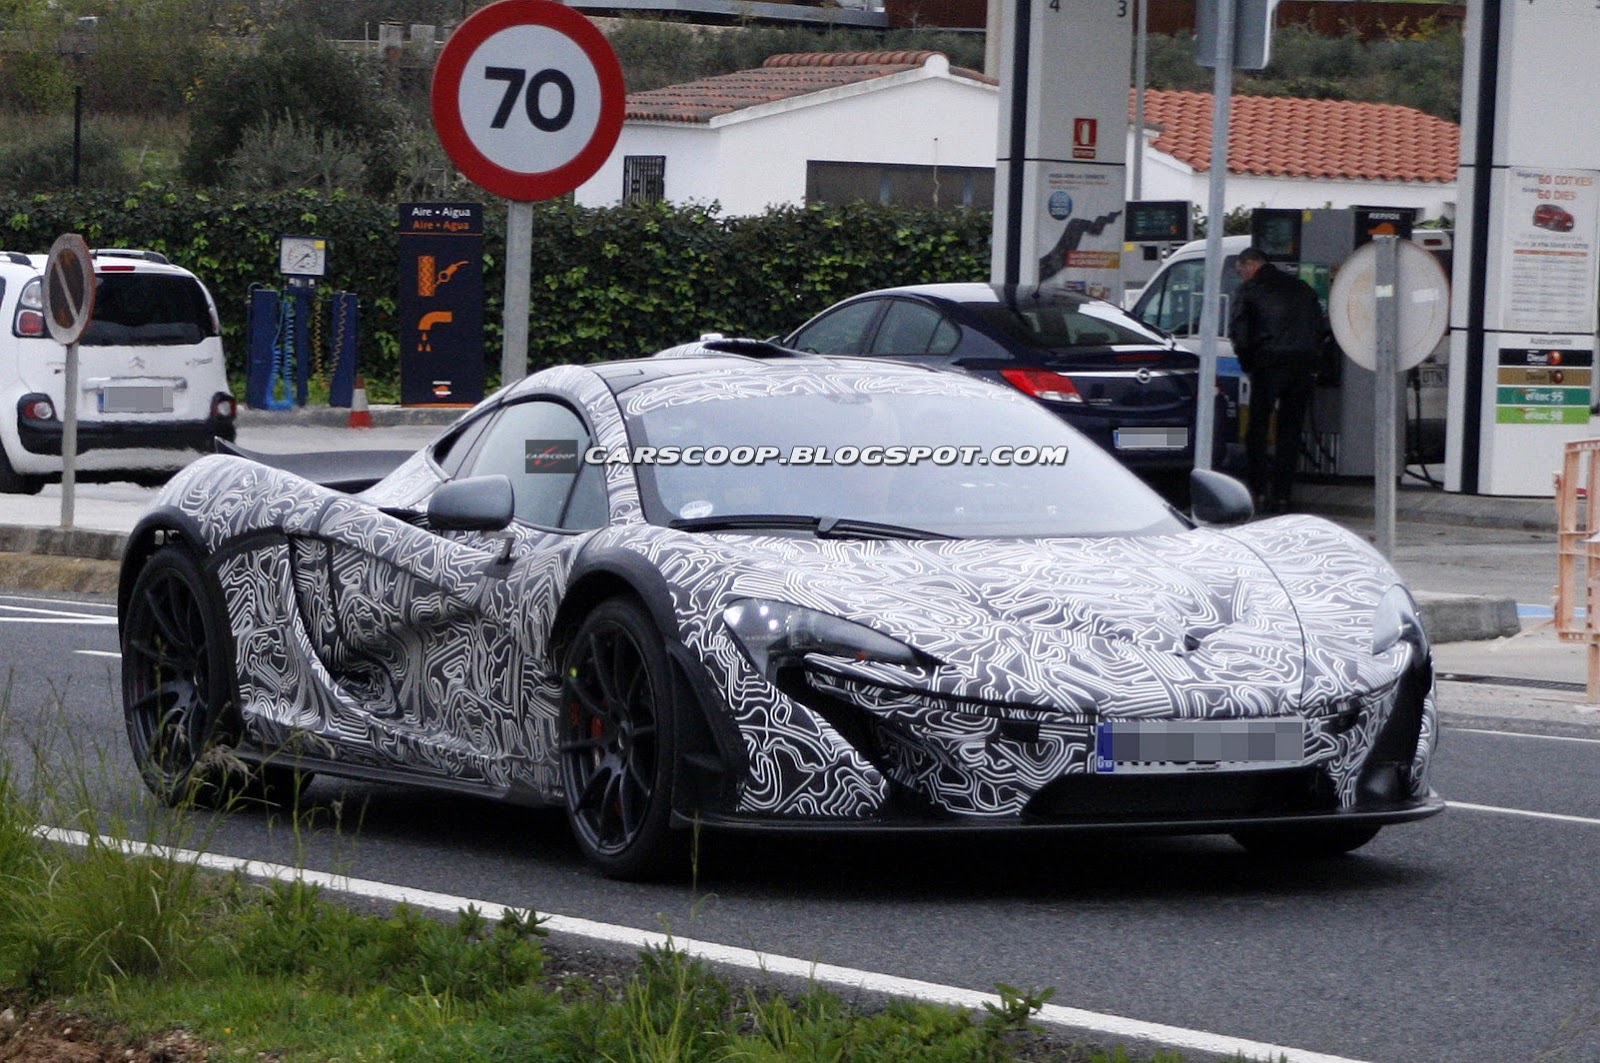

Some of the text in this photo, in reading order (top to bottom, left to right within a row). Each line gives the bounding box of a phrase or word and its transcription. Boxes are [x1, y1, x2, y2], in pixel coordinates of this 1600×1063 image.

[1049, 0, 1060, 12] 4
[1117, 0, 1127, 17] 3
[485, 66, 575, 133] 70
[412, 207, 471, 218] Aire Aigua
[413, 221, 470, 231] Aire Agua
